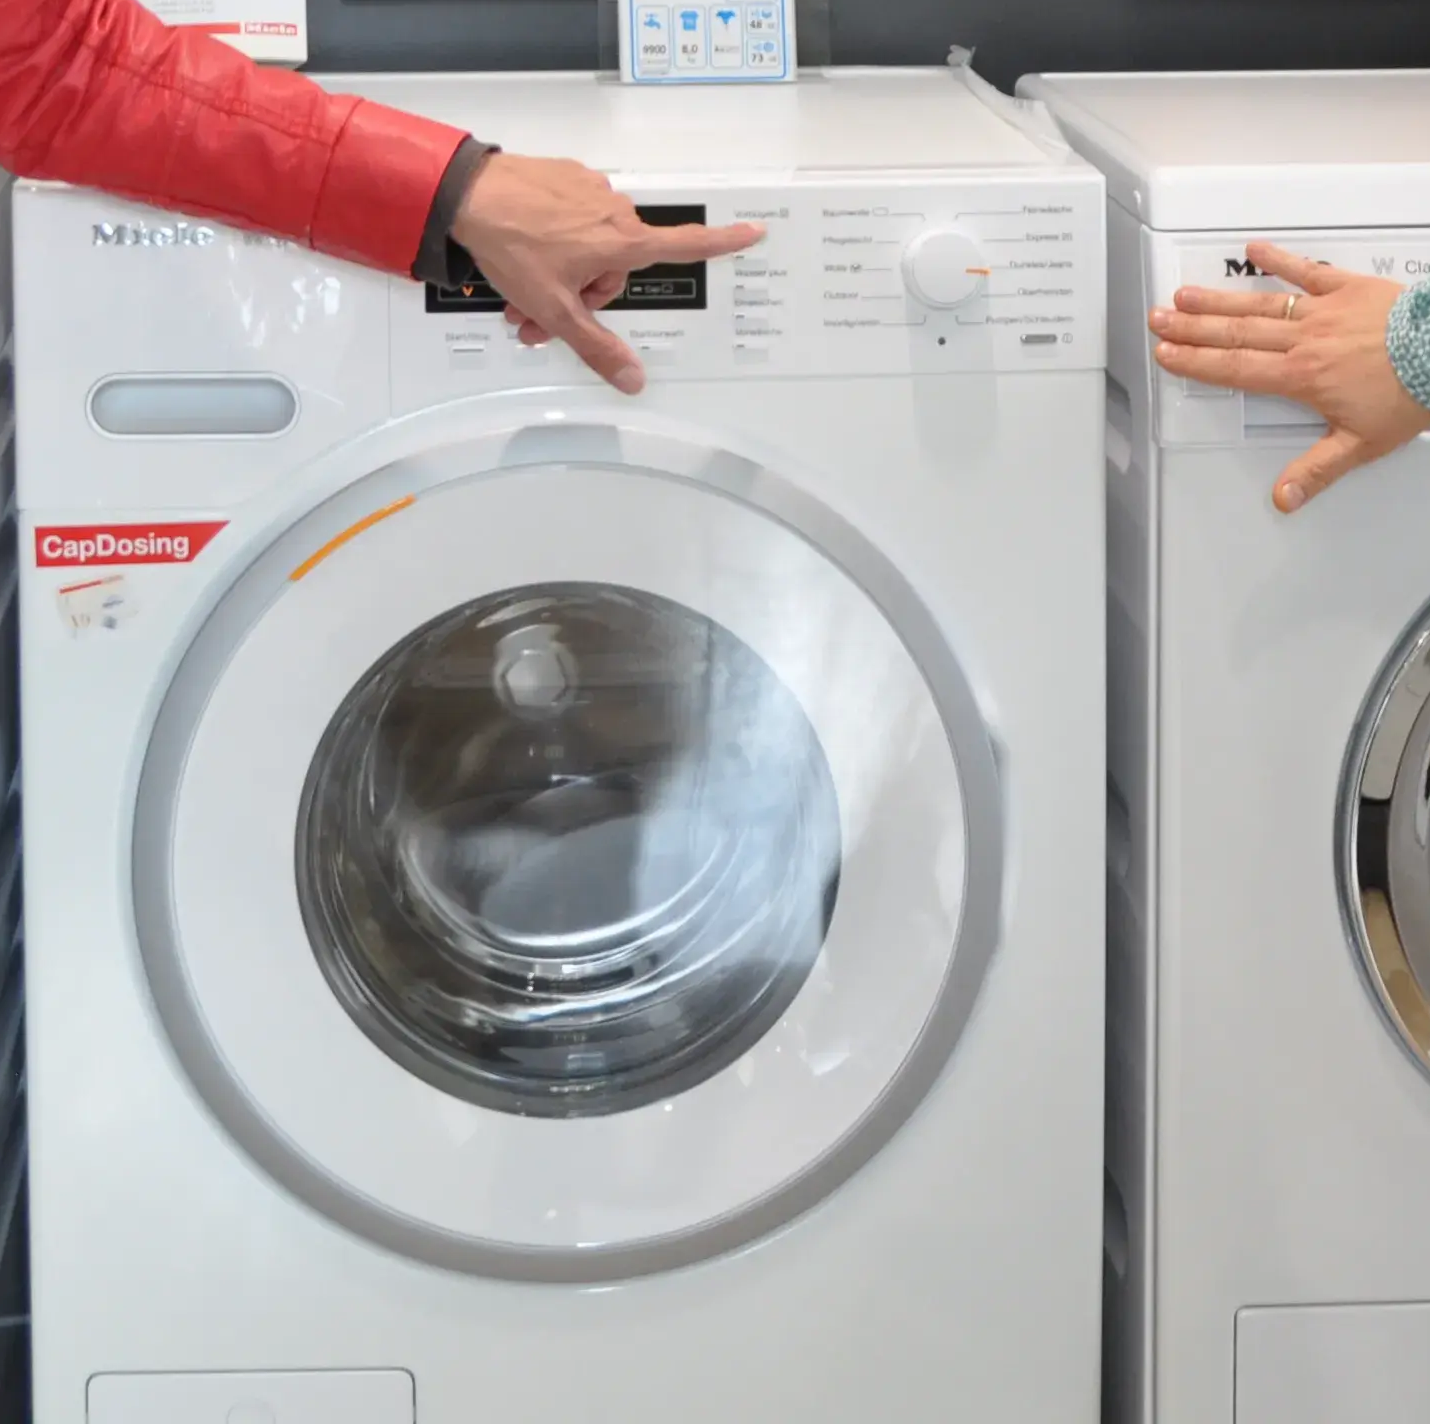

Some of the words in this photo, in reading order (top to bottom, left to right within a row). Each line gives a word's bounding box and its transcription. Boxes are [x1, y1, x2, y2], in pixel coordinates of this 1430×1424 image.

[642, 44, 667, 55] 9900
[92, 221, 214, 247] Miele
[1372, 256, 1395, 275] W
[41, 532, 190, 563] CapDosing
